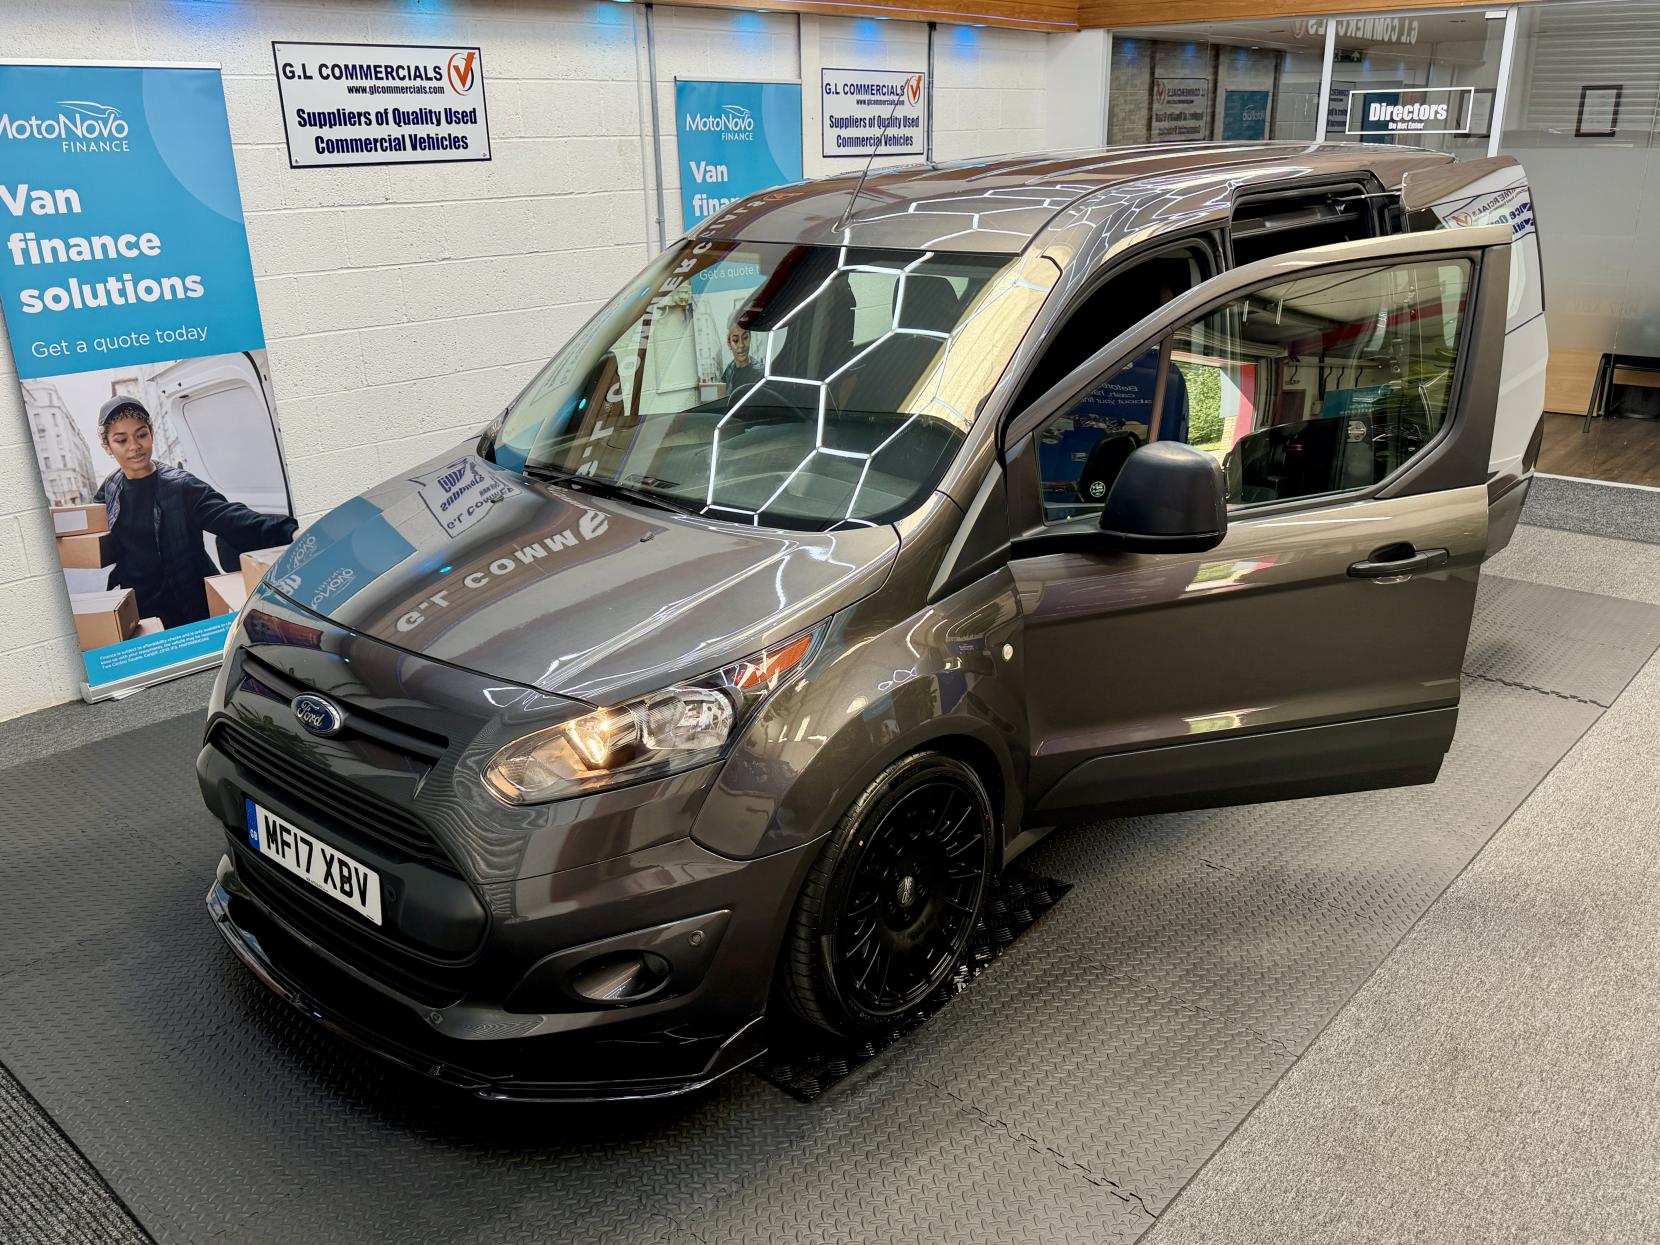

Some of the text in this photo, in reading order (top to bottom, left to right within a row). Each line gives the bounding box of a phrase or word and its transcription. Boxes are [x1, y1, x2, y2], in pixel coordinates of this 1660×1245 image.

[282, 63, 443, 82] G.L COMMERCIALS
[347, 85, 445, 96] www.glcommercials.com
[825, 83, 905, 97] G.L COMMERCIALS
[296, 107, 477, 129] Suppliers of Quality Used
[1369, 102, 1447, 121] Directors
[686, 113, 754, 132] MotoNovo
[829, 115, 920, 129] Suppliers of Quality Used
[1408, 121, 1424, 129] Enter
[315, 133, 469, 154] Commercial Vehicles
[721, 132, 754, 141] FINANCE
[836, 134, 913, 148] Commercial Vehicles
[62, 141, 130, 152] FINANCE
[689, 161, 728, 183] Van
[0, 184, 81, 216] Van
[692, 194, 740, 217] fina
[8, 232, 161, 265] finance
[700, 269, 718, 280] Get
[727, 266, 755, 278] quote
[19, 273, 205, 313] solutions
[31, 323, 207, 358] Get a quote today
[297, 701, 325, 727] Ford
[250, 829, 258, 840] GB
[264, 814, 368, 908] MF17 XBV
